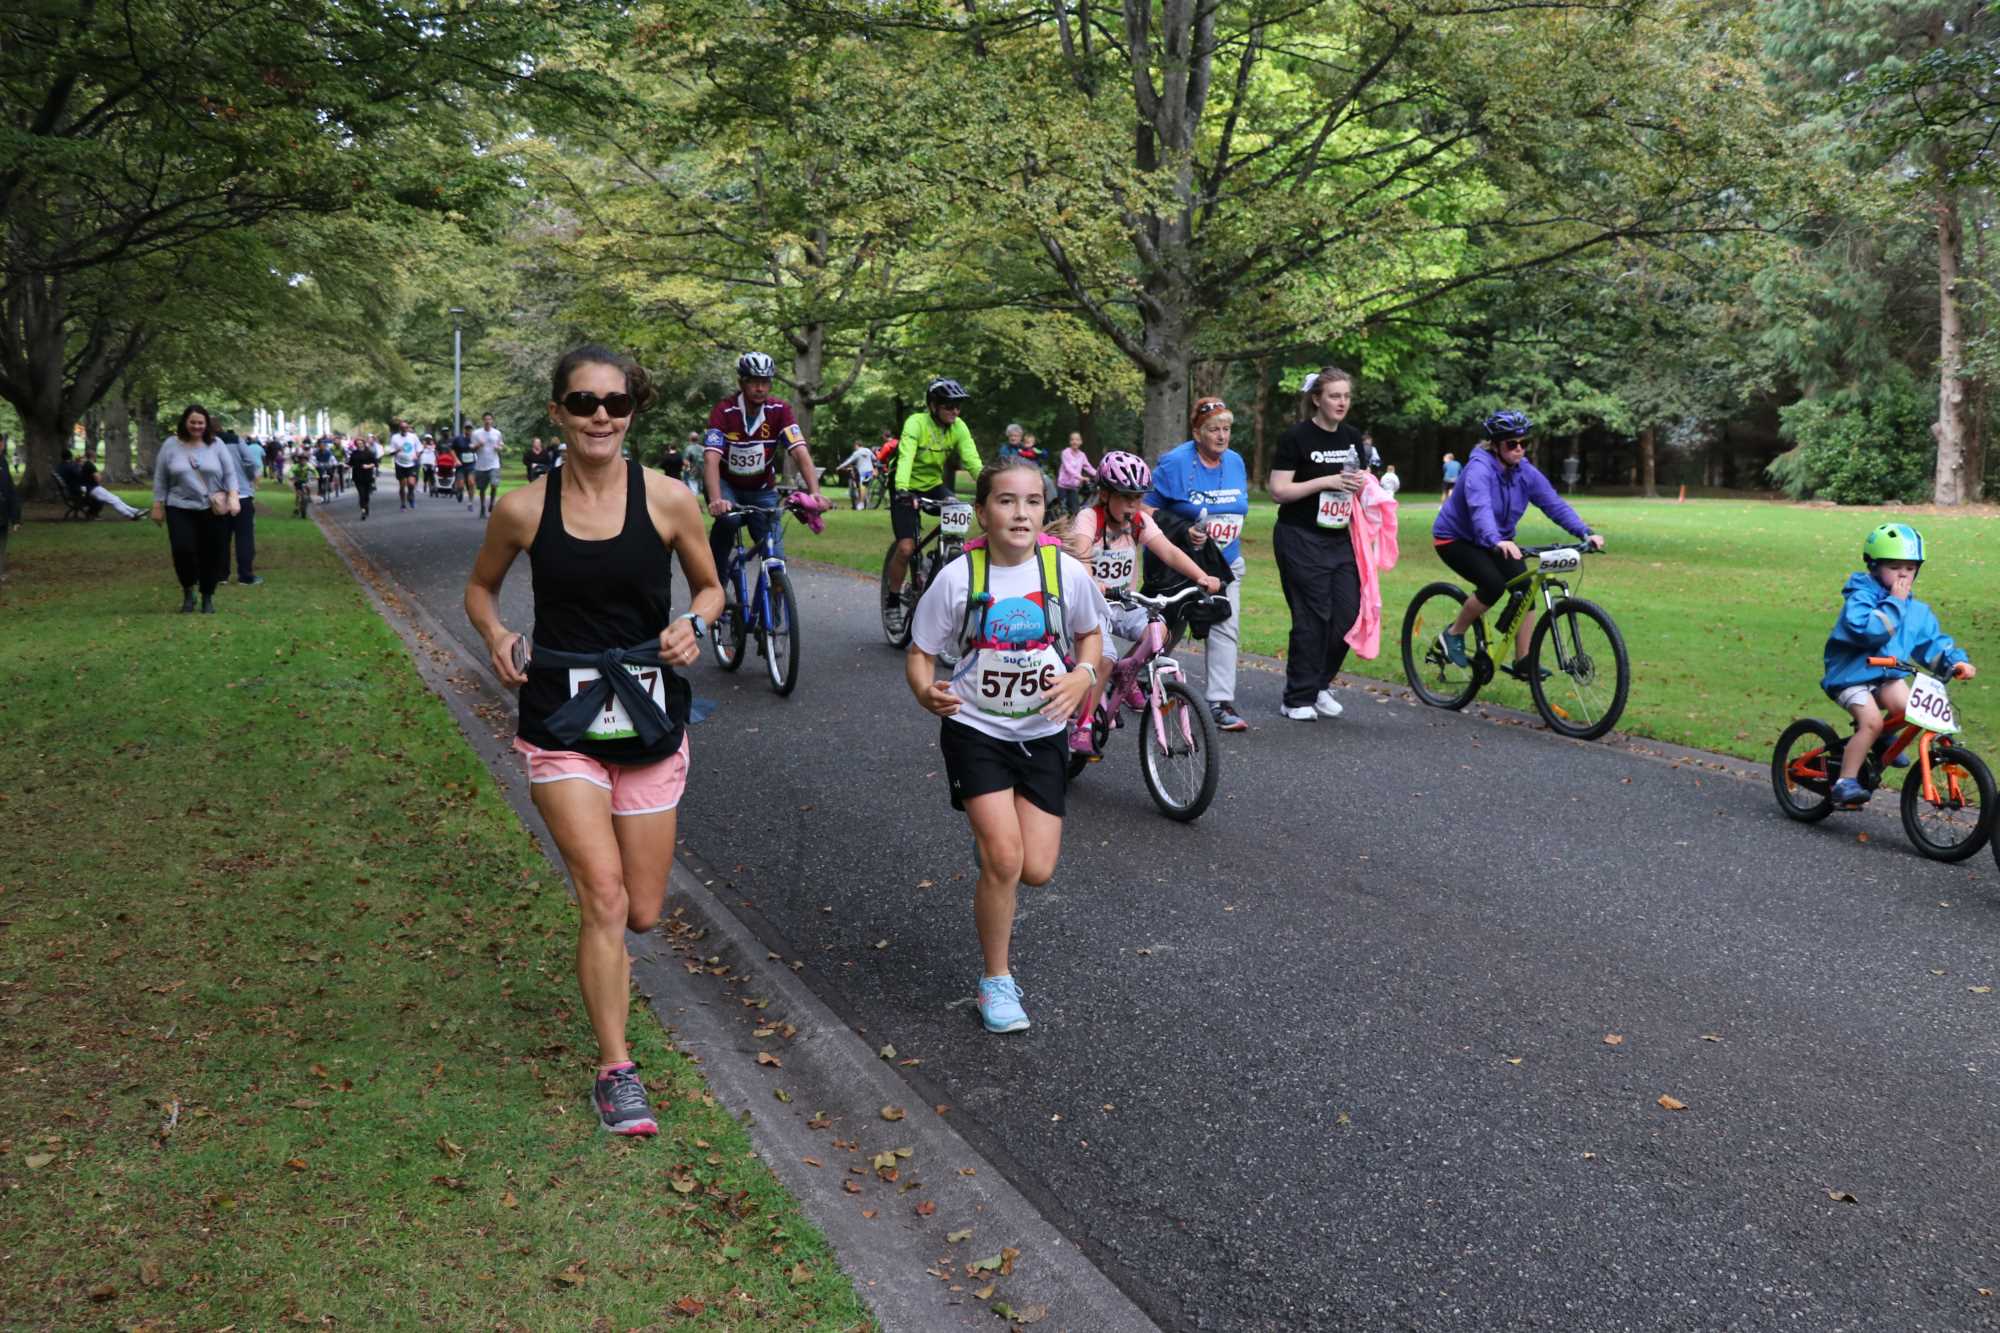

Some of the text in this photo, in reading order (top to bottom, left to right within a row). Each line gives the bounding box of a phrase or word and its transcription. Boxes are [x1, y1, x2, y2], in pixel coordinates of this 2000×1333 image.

[730, 453, 763, 467] 5337
[1320, 501, 1351, 517] 4042
[1540, 558, 1577, 569] 5409
[990, 618, 1041, 640] Tryathlon
[981, 663, 1055, 698] 5756
[1910, 687, 1951, 722] 5408
